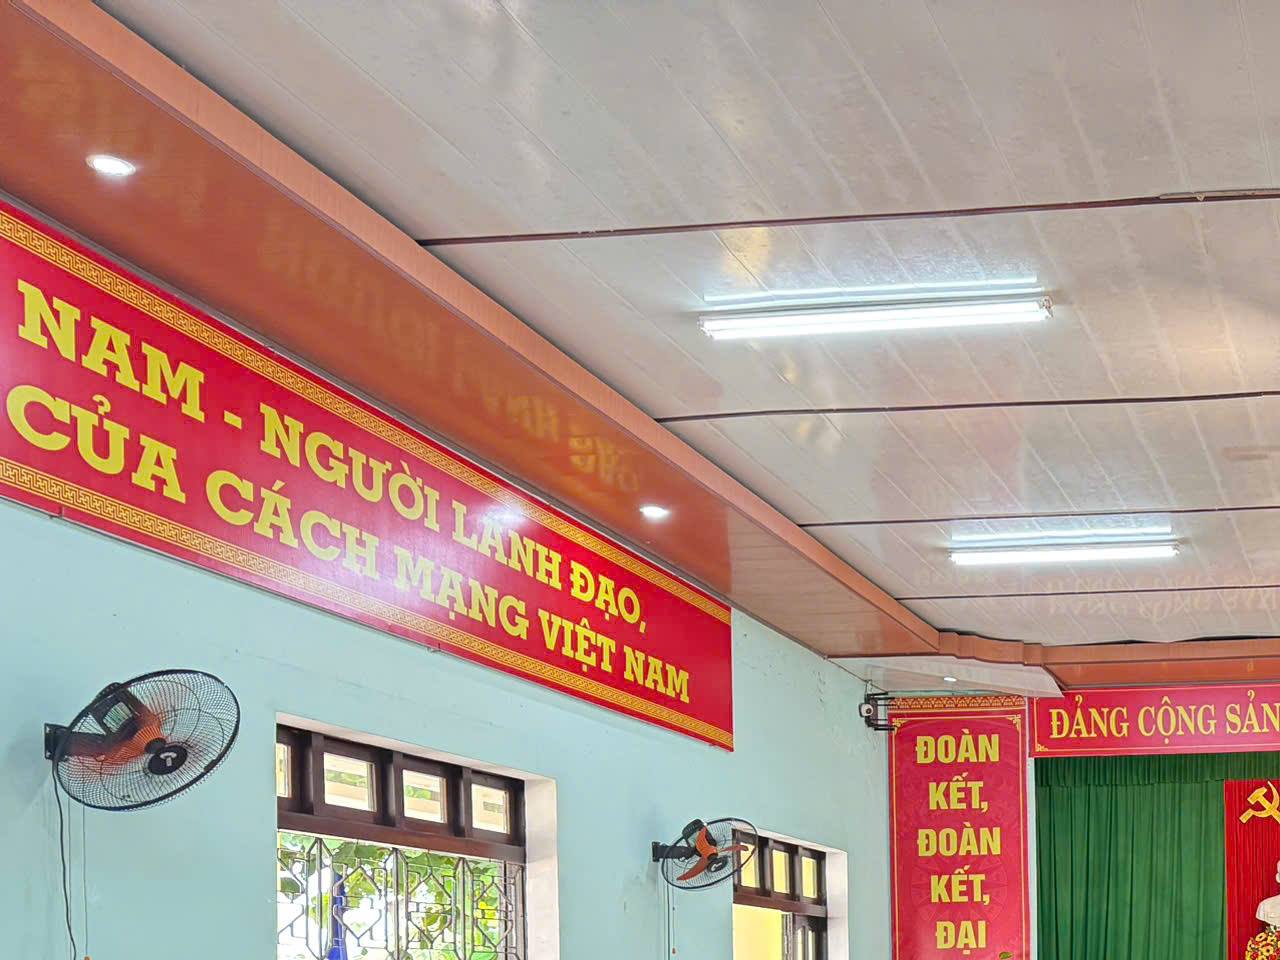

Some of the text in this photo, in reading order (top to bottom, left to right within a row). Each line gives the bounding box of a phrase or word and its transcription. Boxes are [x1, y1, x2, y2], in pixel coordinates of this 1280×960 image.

[17, 278, 206, 424] NAM
[224, 410, 244, 429] -
[260, 403, 441, 534] NGƯỜI
[570, 553, 648, 636] ĐẠO,
[7, 384, 690, 705] CỦA CÁCH MẠNG VIỆT NAM
[1049, 695, 1129, 739] ĐẢNG
[1138, 696, 1217, 745] CỘNG
[916, 728, 1000, 764] ĐOÀN
[928, 772, 989, 812] KẾT,
[918, 822, 1001, 857] ĐOÀN
[930, 865, 991, 906] KẾT,
[936, 920, 987, 955] ĐẠI
